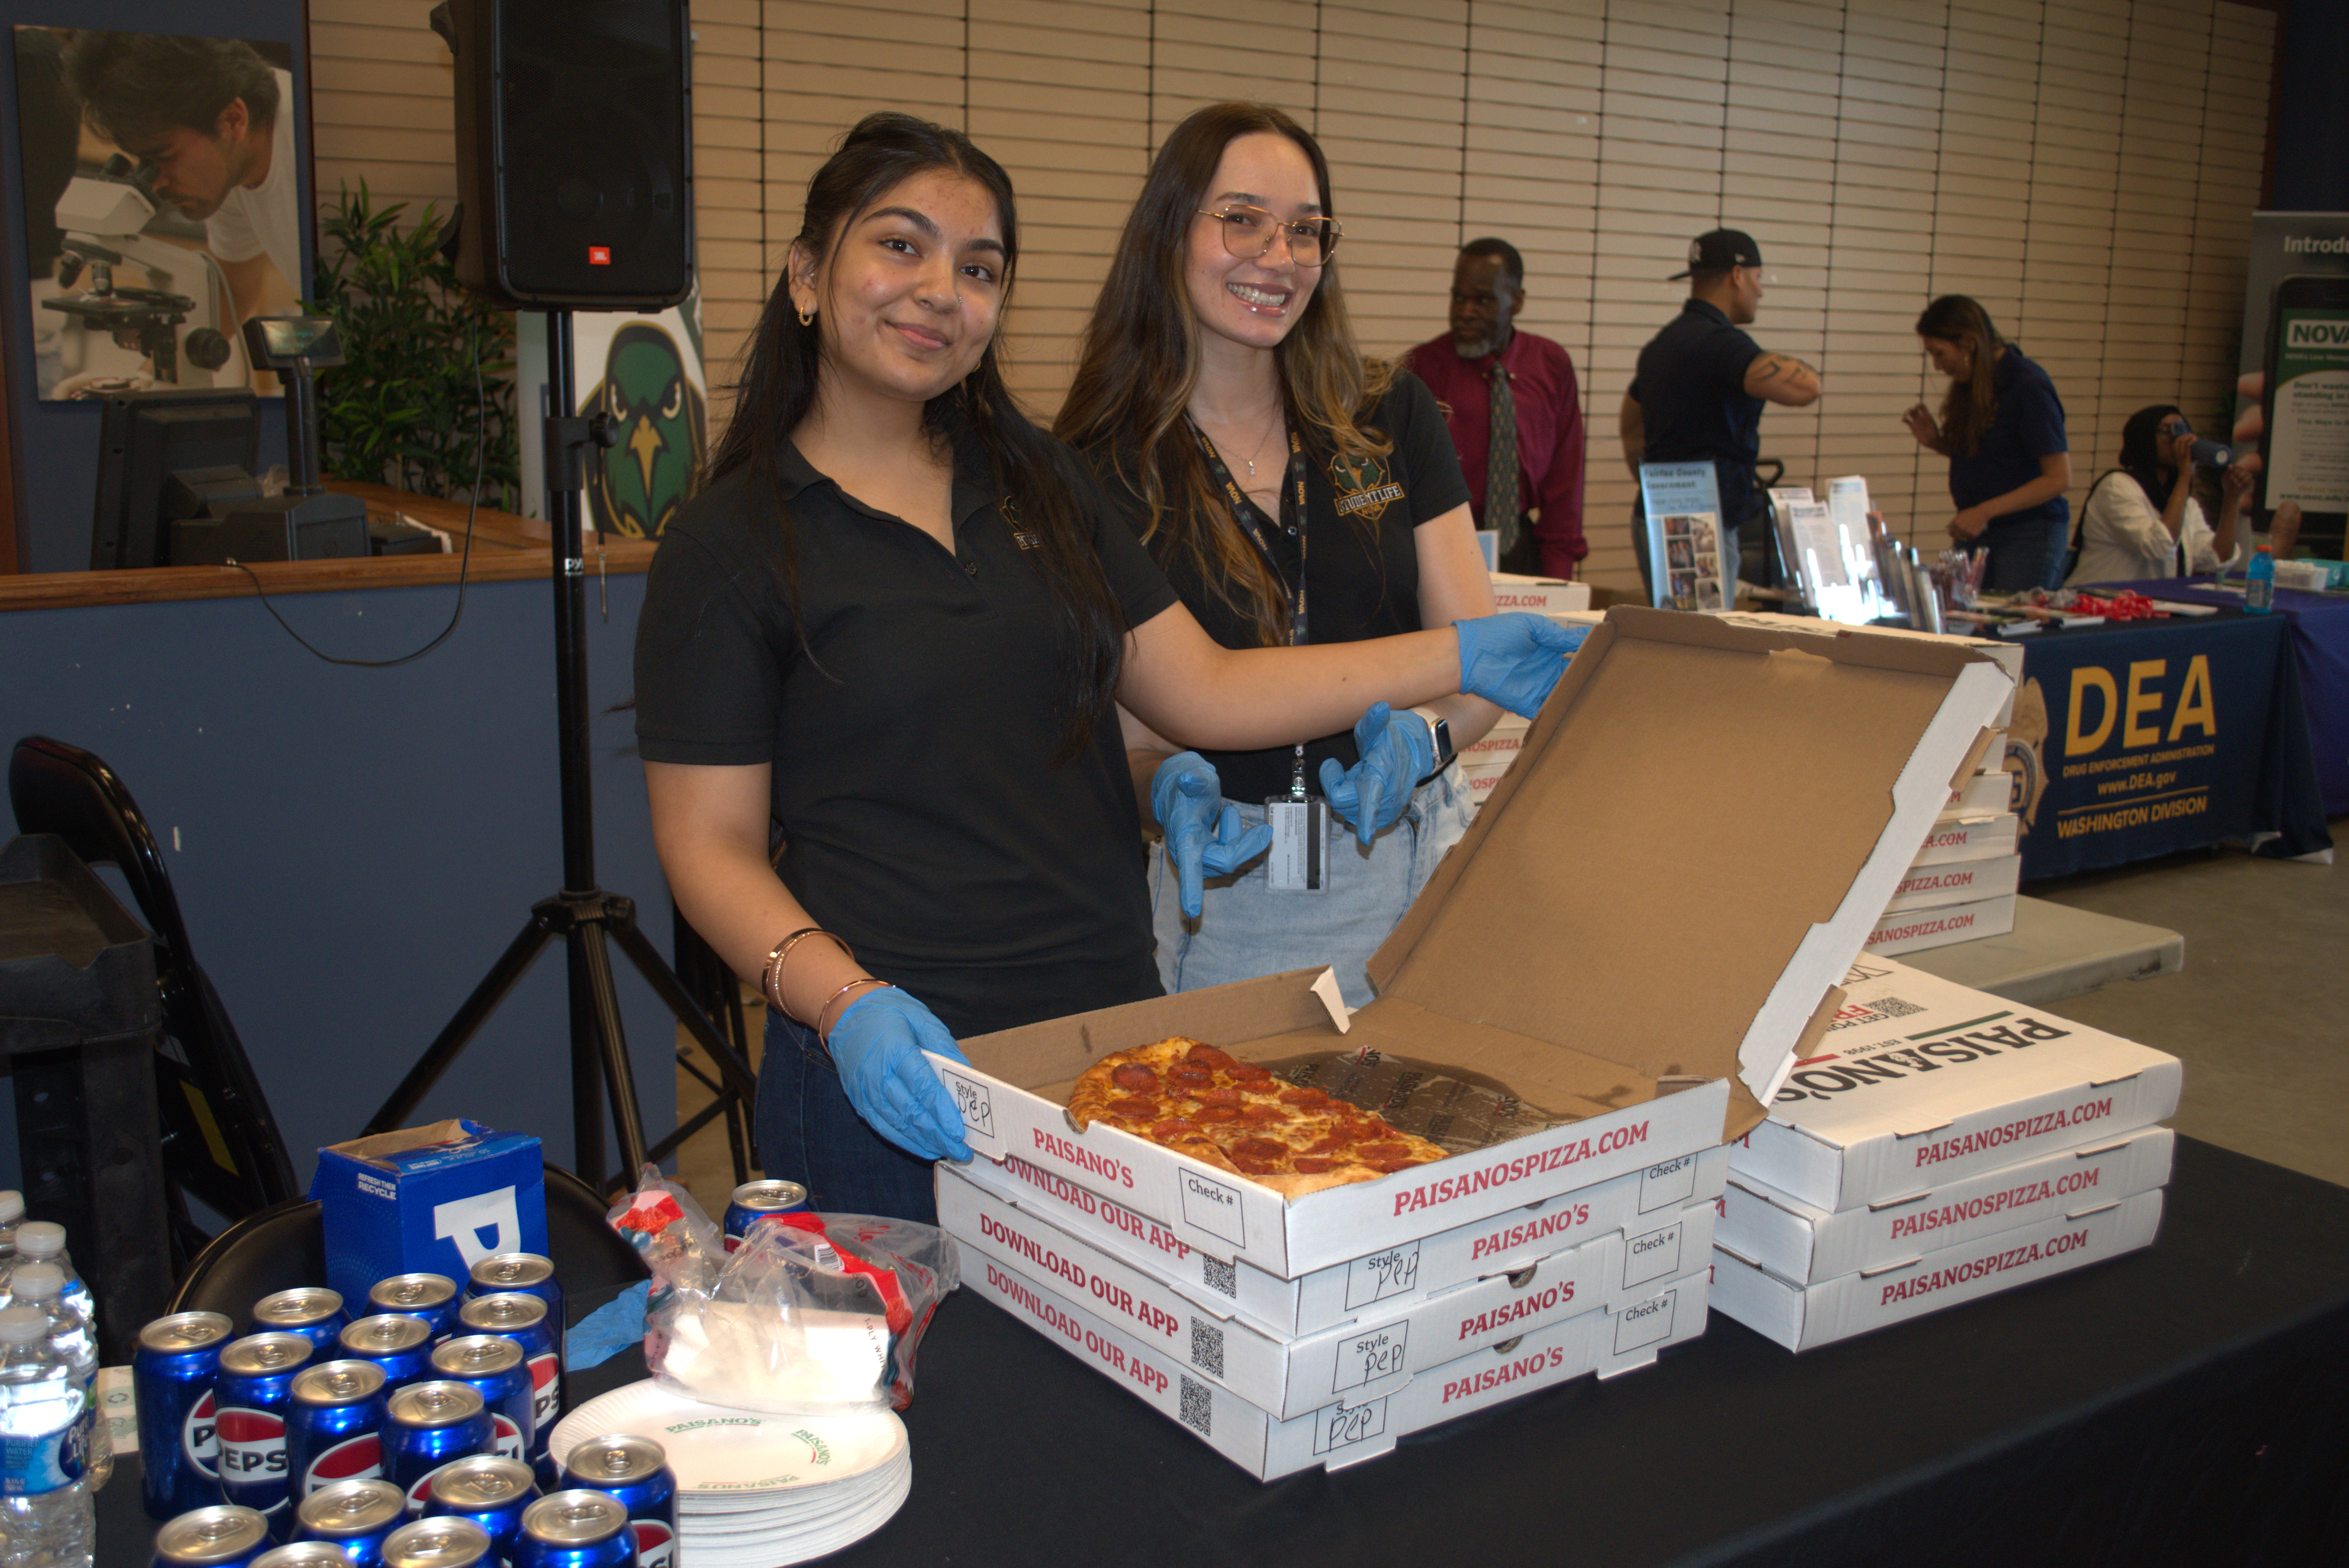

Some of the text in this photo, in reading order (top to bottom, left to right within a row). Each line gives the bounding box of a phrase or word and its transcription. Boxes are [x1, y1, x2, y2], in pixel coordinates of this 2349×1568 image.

[2284, 235, 2349, 253] Introd
[1226, 481, 1242, 504] NOVA
[1378, 485, 1401, 501] LIFE
[2065, 654, 2216, 757] DEA
[2062, 743, 2215, 778] DRUG ENFORCEMENT ADMINISTRATION
[2098, 771, 2178, 796] www.DEA.gov
[2057, 795, 2208, 839] WASHINGTON DIVISION
[1855, 1014, 1889, 1024] GET
[956, 1082, 977, 1099] Style
[1915, 1098, 2112, 1167] PAISANOSPIZZA.COM
[1033, 1127, 1134, 1188] PAISANO'S
[1394, 1121, 1649, 1216] PAISANOSPIZZA.COM
[1650, 1158, 1681, 1179] Check
[358, 1172, 396, 1191] REFRESH THEN
[358, 1181, 397, 1200] RECYCLE
[1189, 1179, 1224, 1203] Check
[1891, 1168, 2099, 1239] PAISANOSPIZZA.COM
[1100, 1201, 1145, 1240] OUR
[1149, 1224, 1191, 1259] APP
[1472, 1204, 1589, 1260] PAISANO'S
[1633, 1233, 1665, 1254] Check
[1368, 1250, 1401, 1270] Style
[1881, 1229, 2088, 1305] PAISANOSPIZZA.COM
[980, 1213, 1086, 1287] DOWNLOAD
[1091, 1275, 1134, 1316] OUR
[1137, 1300, 1179, 1337] APP
[1458, 1281, 1574, 1340] PAISANO'S
[1625, 1301, 1657, 1321] Check
[987, 1264, 1168, 1393] DOWNLOAD OUR APP
[1356, 1333, 1388, 1353] Style
[1442, 1347, 1563, 1403] PAISANO'S
[664, 1417, 762, 1432] PAISANO'S
[5, 1447, 33, 1455] WATER
[795, 1429, 831, 1466] PAISANO'S
[219, 1448, 287, 1472] EPS
